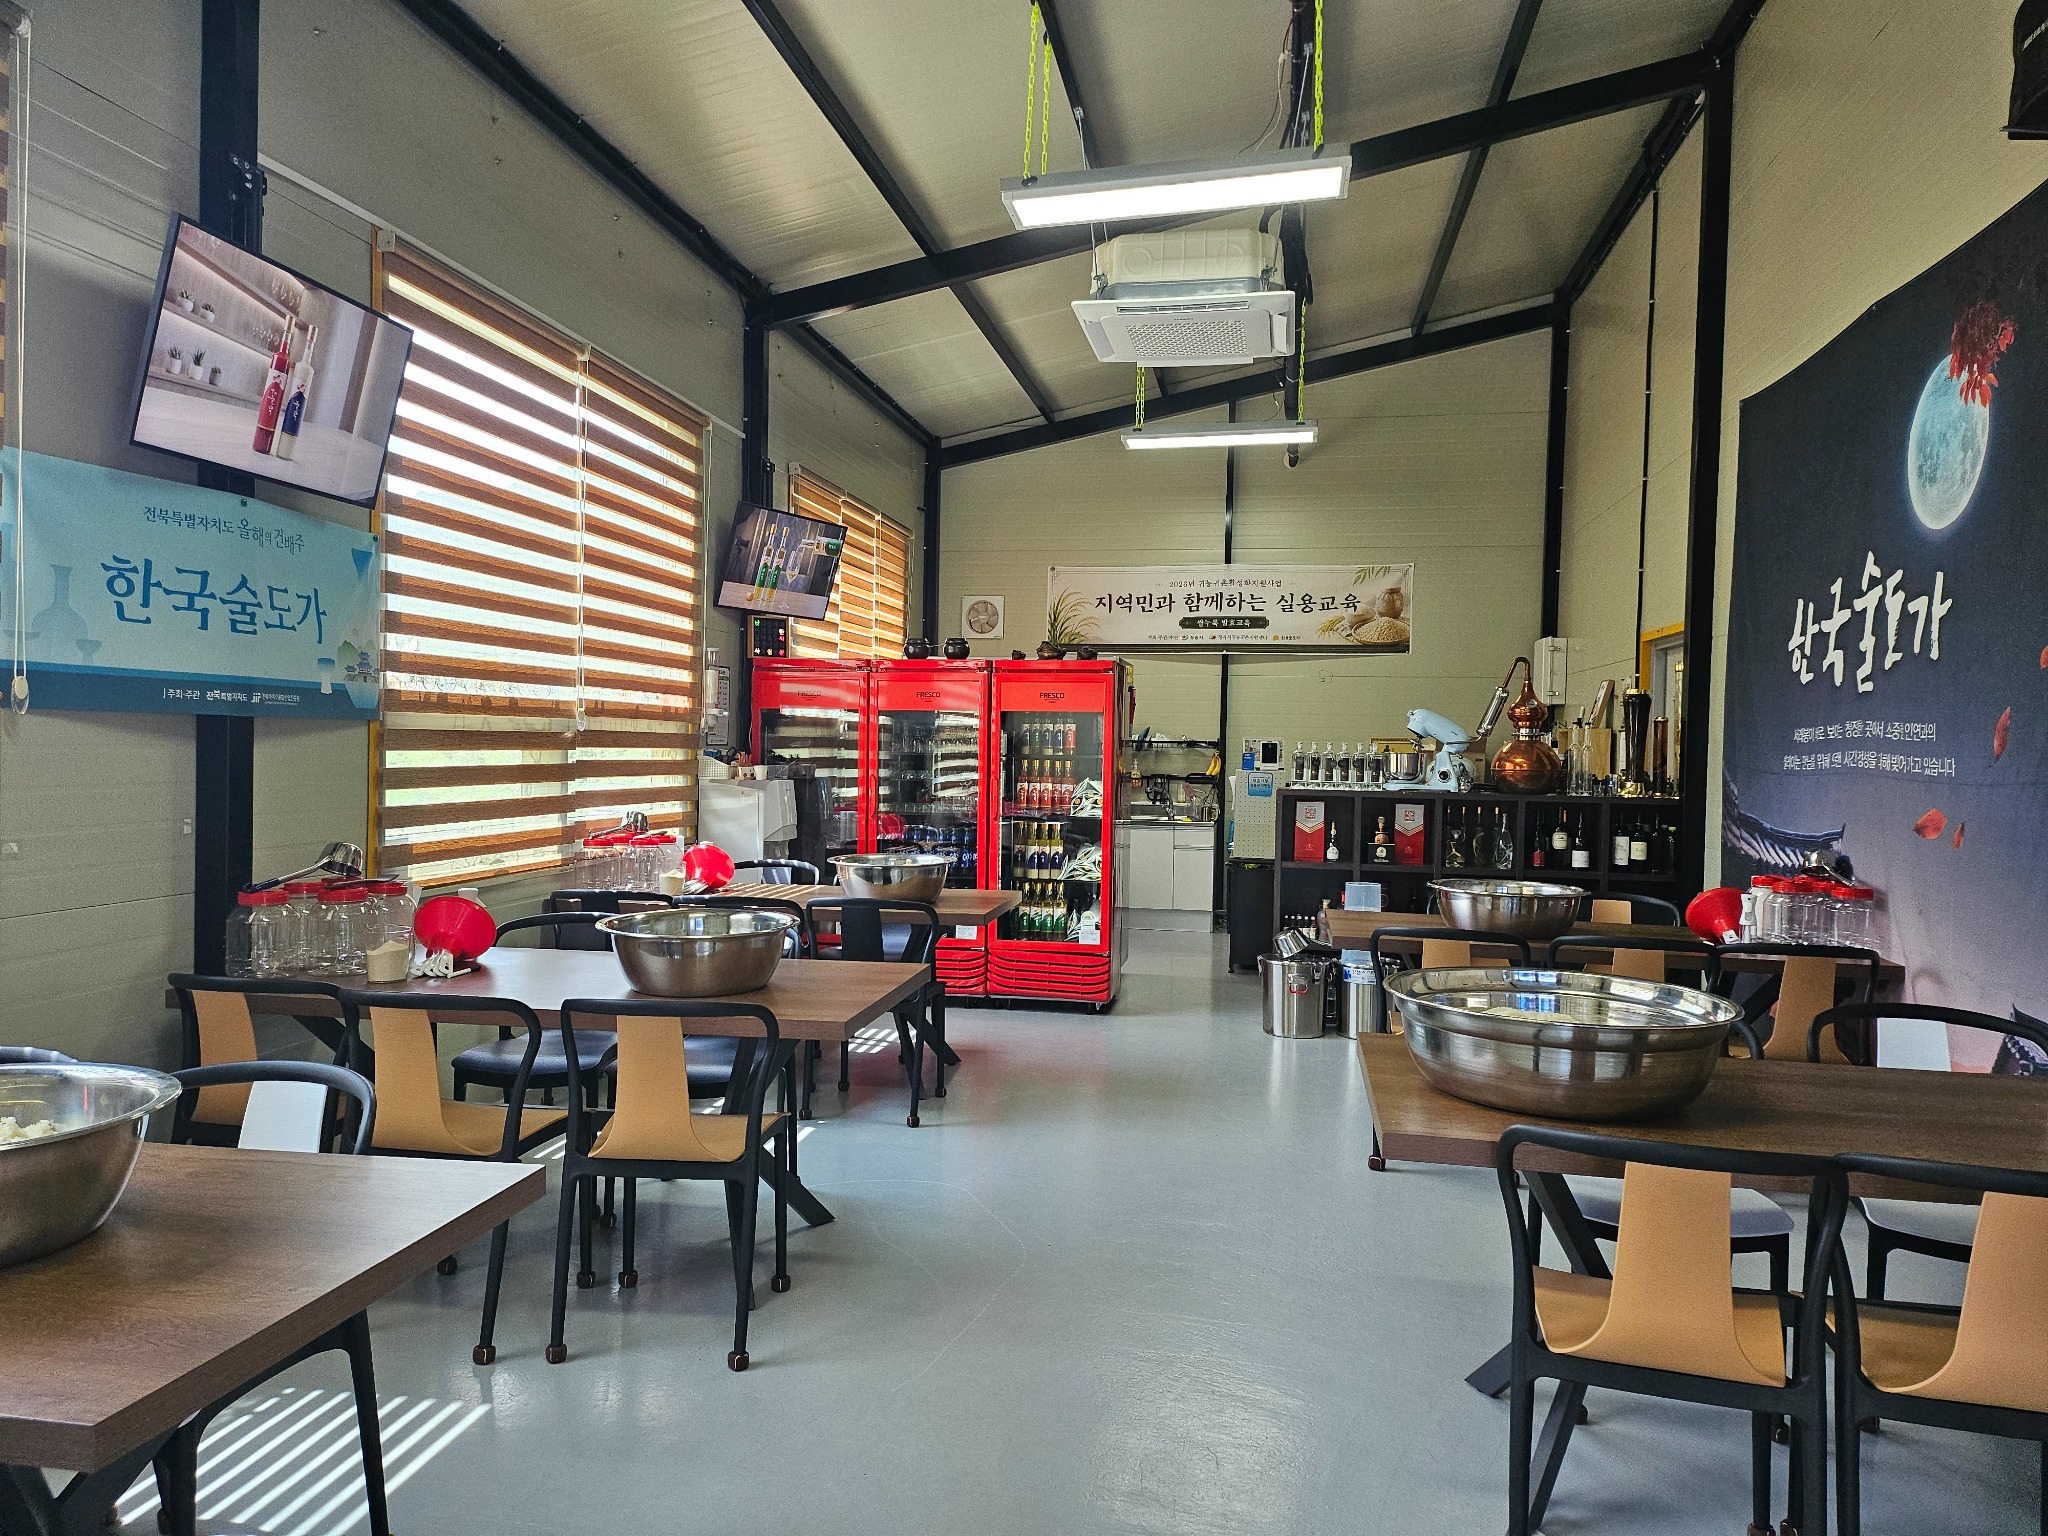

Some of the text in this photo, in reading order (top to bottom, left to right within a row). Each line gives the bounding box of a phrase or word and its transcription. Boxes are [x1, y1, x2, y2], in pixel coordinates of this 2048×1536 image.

[143, 506, 305, 555] 전북특별자치도 올해의 건배주
[100, 554, 328, 645] 한국술도가
[1094, 591, 1361, 614] 지역민과 함께하는 실용교육
[1788, 550, 1953, 693] 한국술도가
[206, 689, 248, 702] 전북특별자치도
[1904, 722, 1936, 742] 인연과의
[1923, 756, 1956, 778] 있습니다
